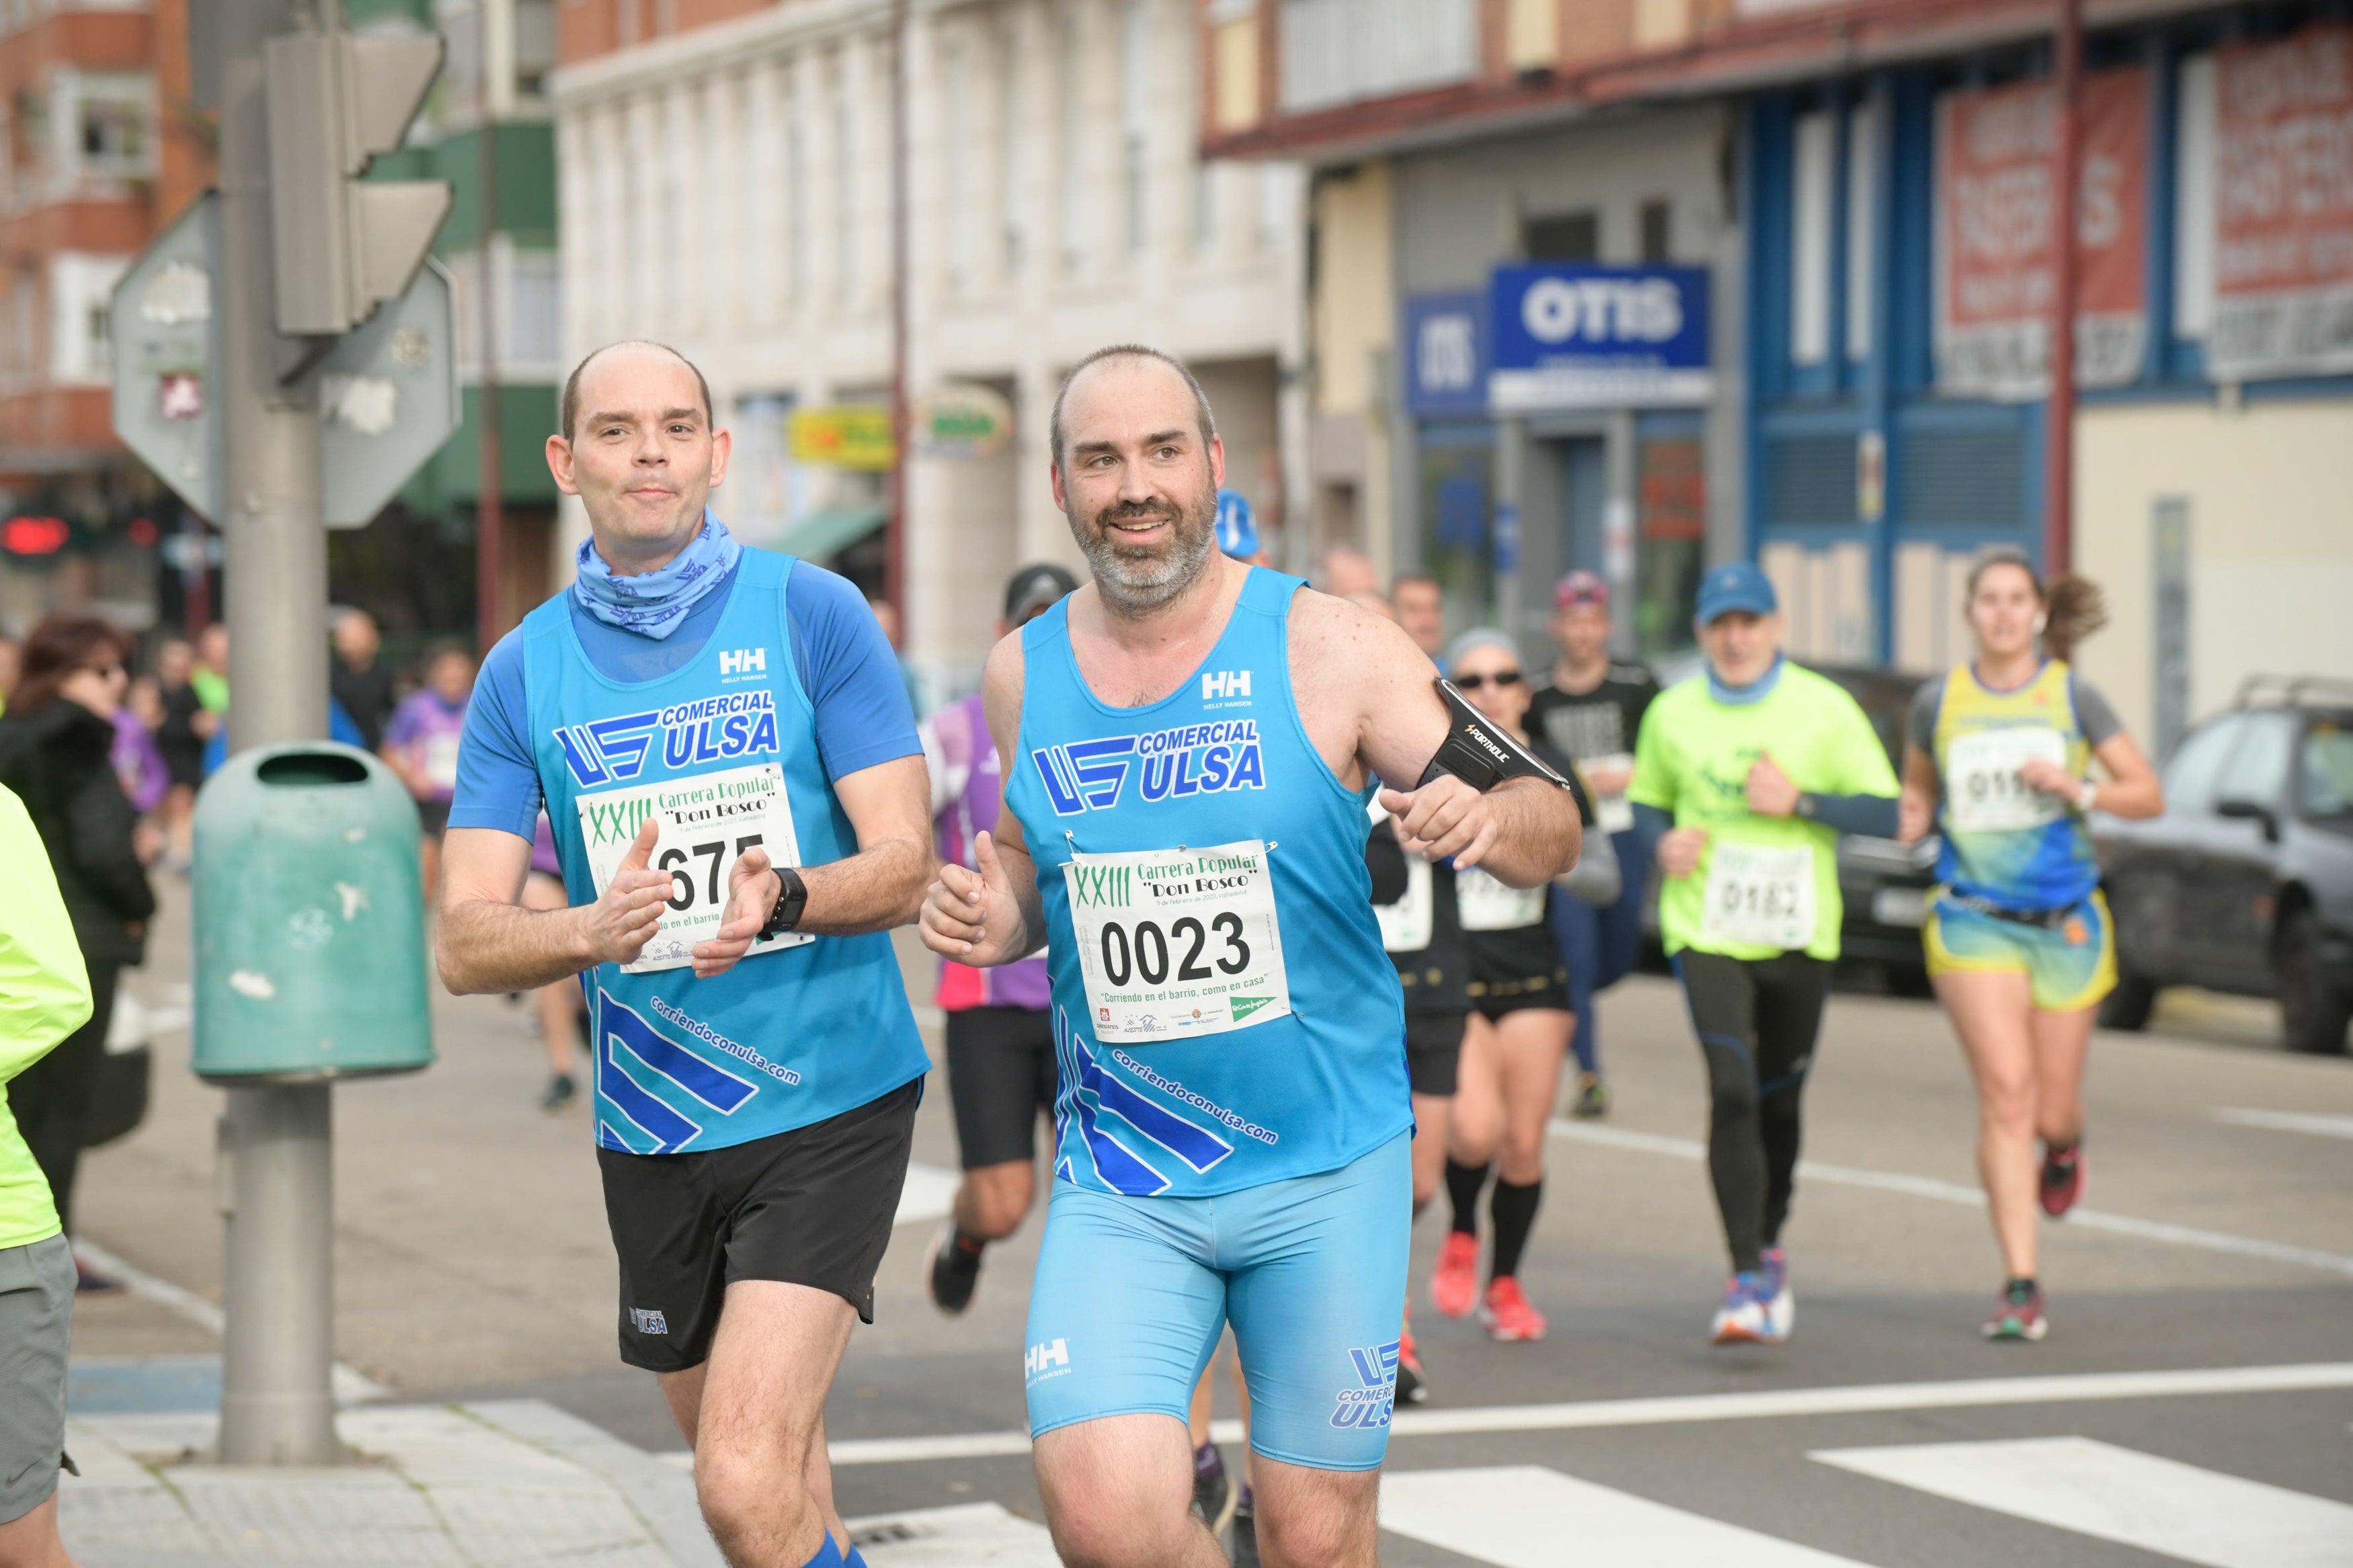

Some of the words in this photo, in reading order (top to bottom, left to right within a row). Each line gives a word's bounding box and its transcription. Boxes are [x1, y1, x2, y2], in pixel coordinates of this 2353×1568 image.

[1521, 278, 1683, 343] OTIS
[719, 648, 766, 675] HH
[1202, 670, 1251, 700] HH
[661, 691, 774, 726] COMERCIAL
[664, 712, 779, 768] ULSA
[1138, 720, 1259, 755] COMERCIAL
[1141, 743, 1265, 800] ULSA
[659, 787, 714, 810] Carrera
[718, 777, 775, 798] Popular
[692, 821, 713, 830] febrero
[739, 813, 766, 823] Valladolid
[1075, 865, 1130, 909] XXIII
[1138, 863, 1193, 880] Carrera
[1198, 854, 1259, 874] Popular
[1170, 897, 1193, 905] febrero
[1203, 893, 1218, 901] 2020,
[1219, 889, 1247, 899] Valladolid
[670, 920, 681, 930] en
[684, 917, 691, 926] el
[1101, 911, 1250, 987] 0023
[1145, 993, 1156, 1001] en
[1158, 991, 1166, 1000] el
[1169, 988, 1199, 999] barrio,
[1203, 986, 1227, 996] como
[1230, 983, 1241, 991] en
[651, 995, 801, 1085] corriendoconulsa.com
[1113, 1049, 1278, 1145] corriendoconulsa.com
[636, 1309, 664, 1317] MERCIAL
[637, 1318, 668, 1333] ULSA
[1038, 1367, 1071, 1382] HANSEN
[1337, 1385, 1395, 1402] COMERC
[1330, 1398, 1392, 1429] ULS
